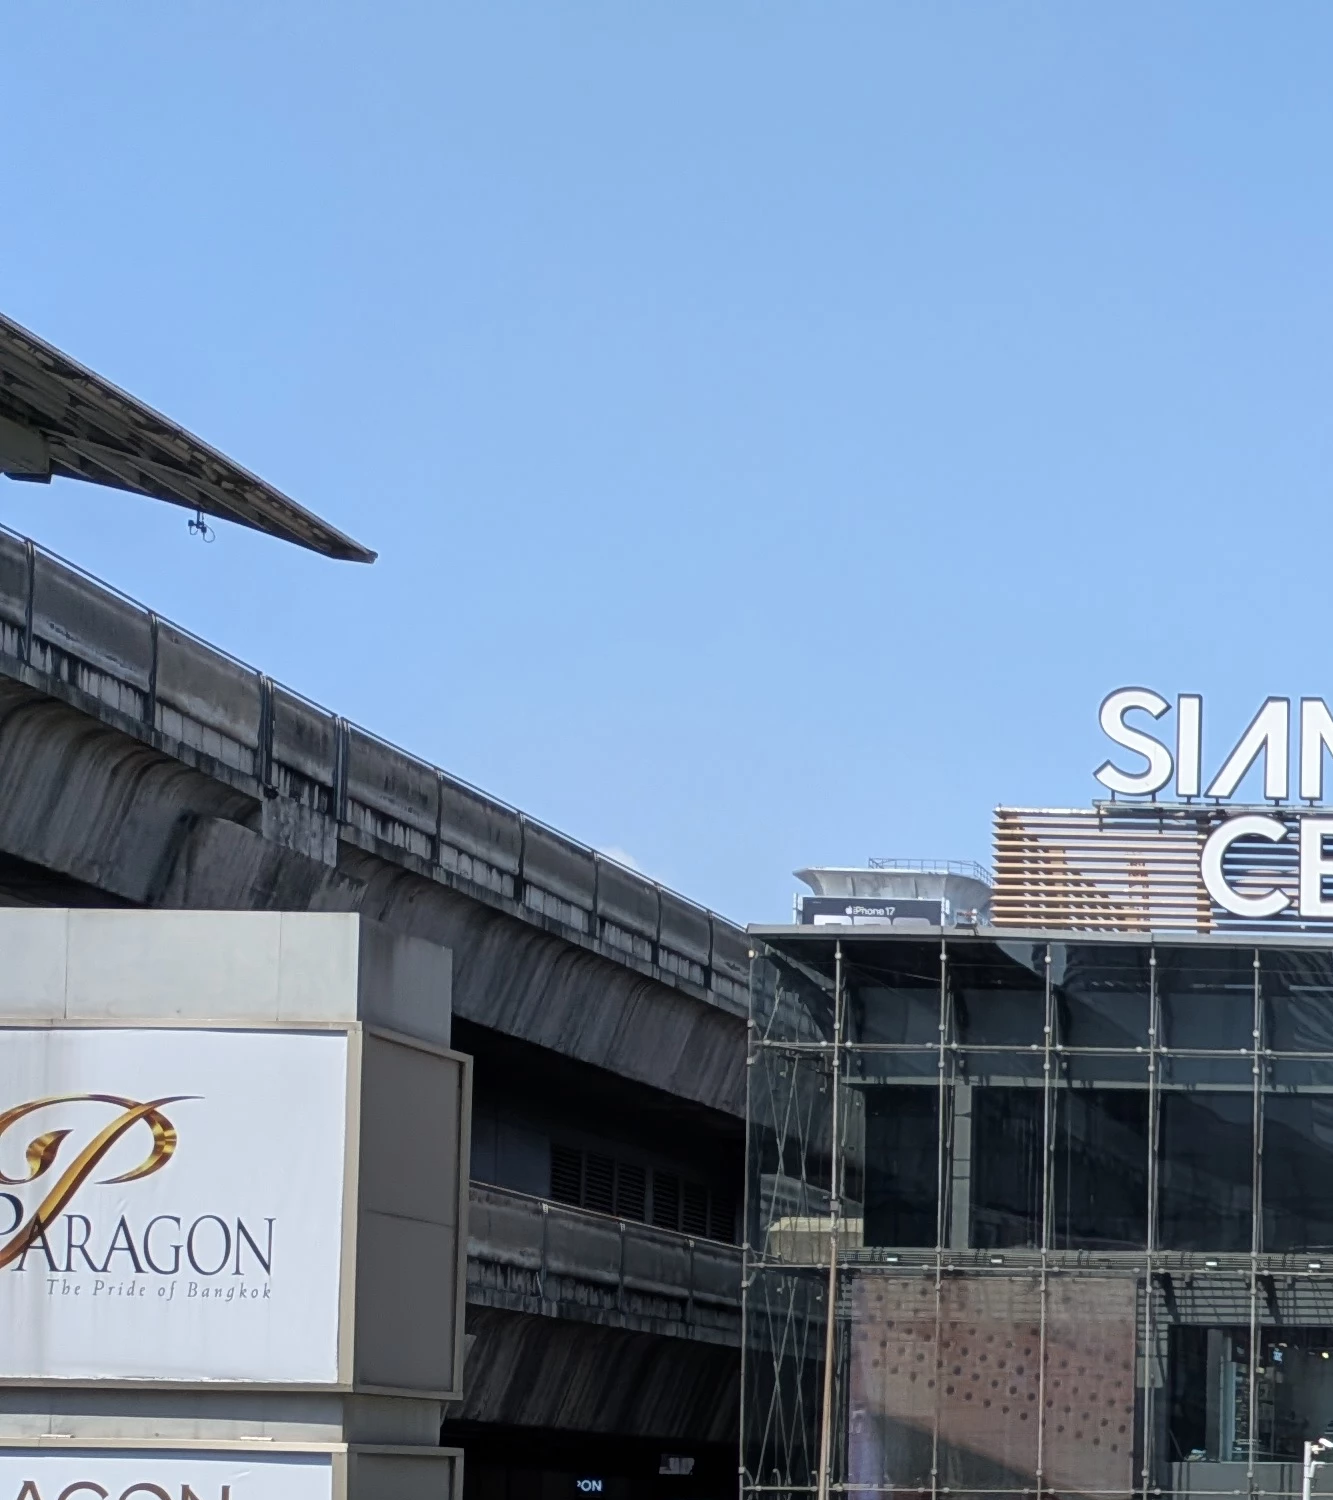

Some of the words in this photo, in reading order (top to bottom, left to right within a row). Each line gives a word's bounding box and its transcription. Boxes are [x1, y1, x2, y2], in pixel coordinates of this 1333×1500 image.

[46, 1278, 85, 1298] The
[92, 1278, 147, 1298] Pride
[157, 1278, 177, 1301] of
[187, 1280, 273, 1303] Bangkok
